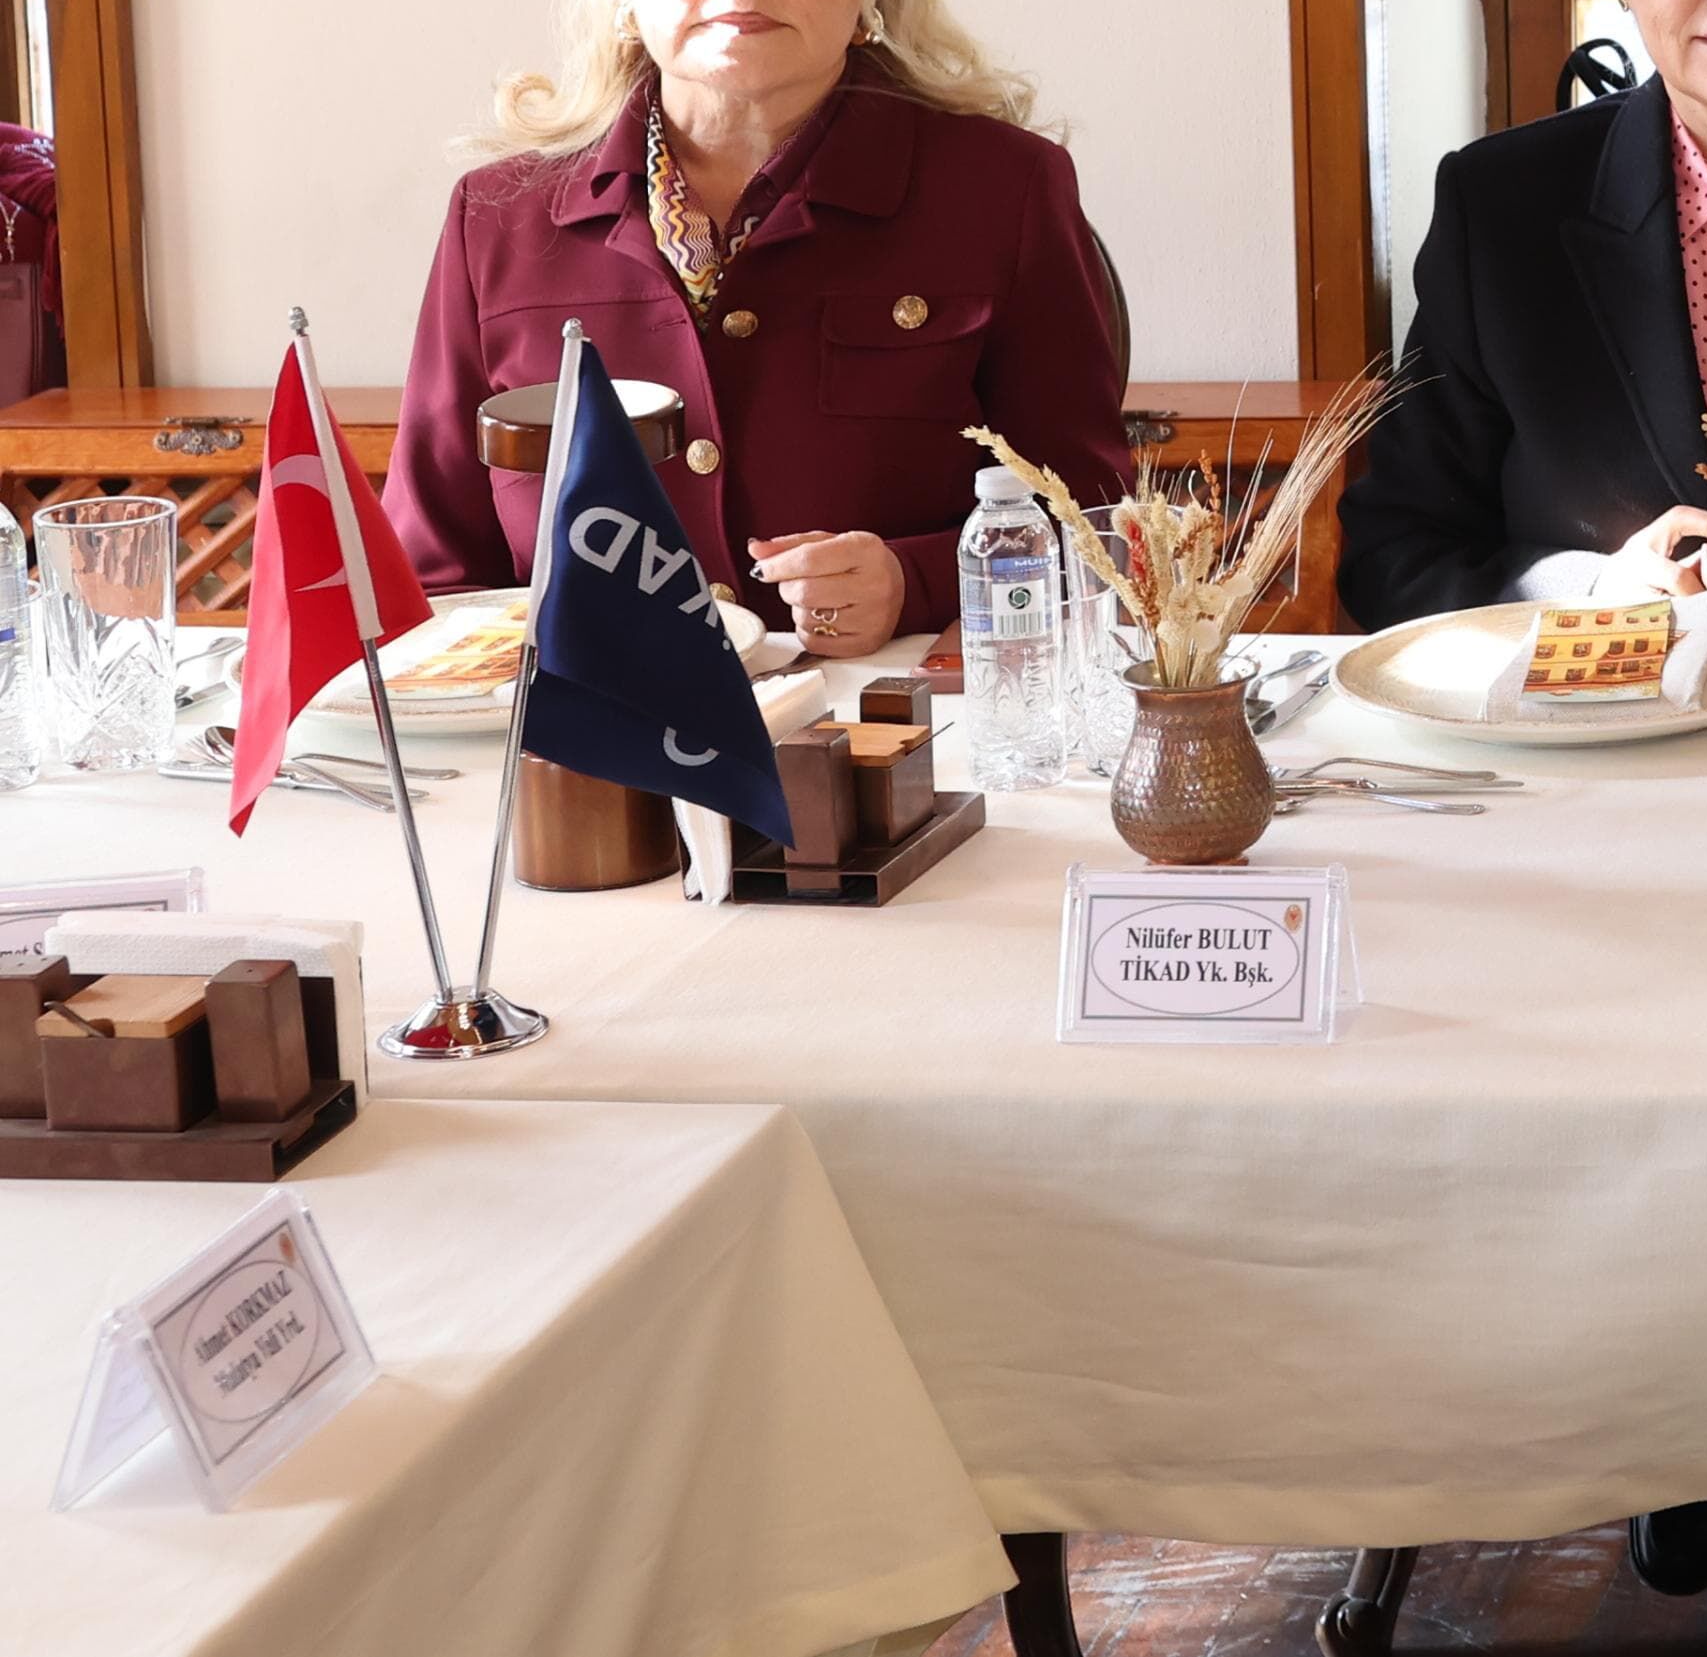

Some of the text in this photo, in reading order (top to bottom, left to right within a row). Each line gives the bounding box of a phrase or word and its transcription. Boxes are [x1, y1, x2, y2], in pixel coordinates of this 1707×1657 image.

[1125, 927, 1272, 951] Nilüfer BULUT
[1120, 955, 1273, 988] TİKAD Yk. Bşk.
